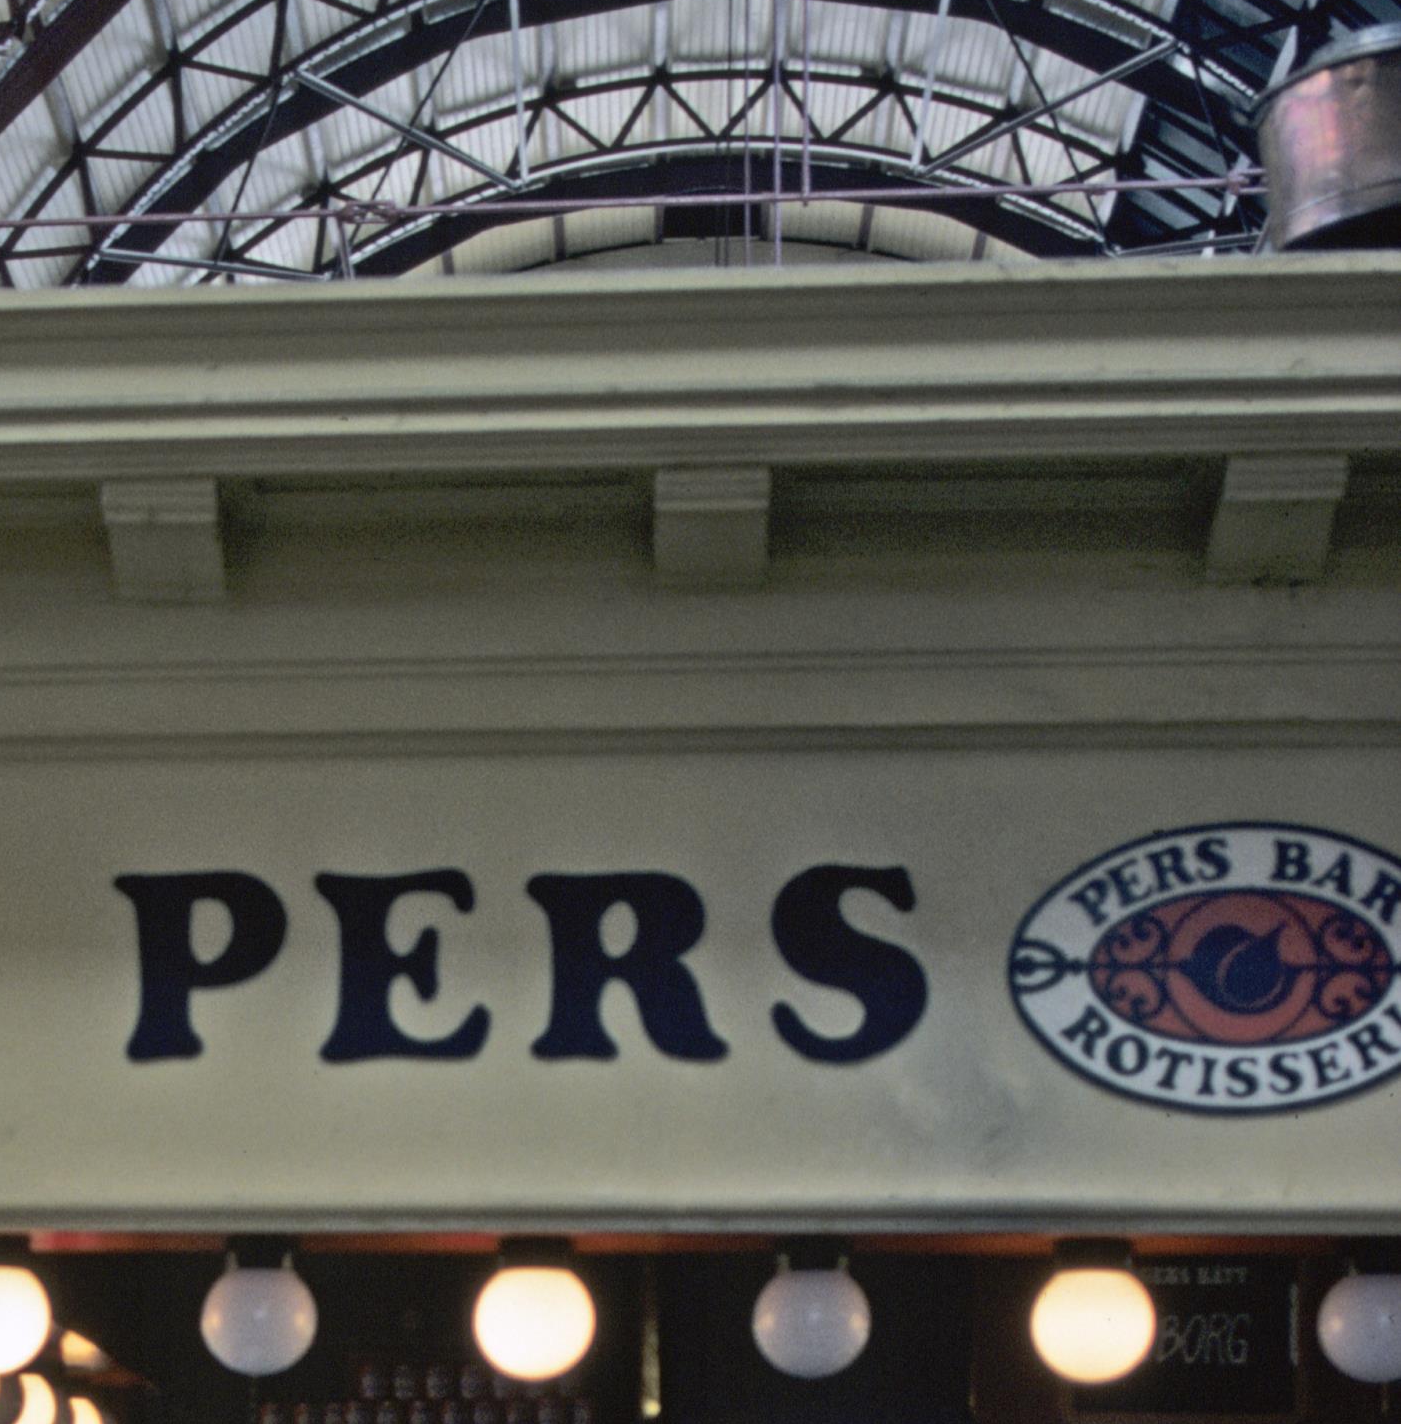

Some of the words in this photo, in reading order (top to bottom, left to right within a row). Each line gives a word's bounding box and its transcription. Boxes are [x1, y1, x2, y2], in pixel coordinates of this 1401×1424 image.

[1068, 837, 1231, 927] PERS
[1271, 839, 1401, 925] BAR
[113, 863, 930, 1065] PERS
